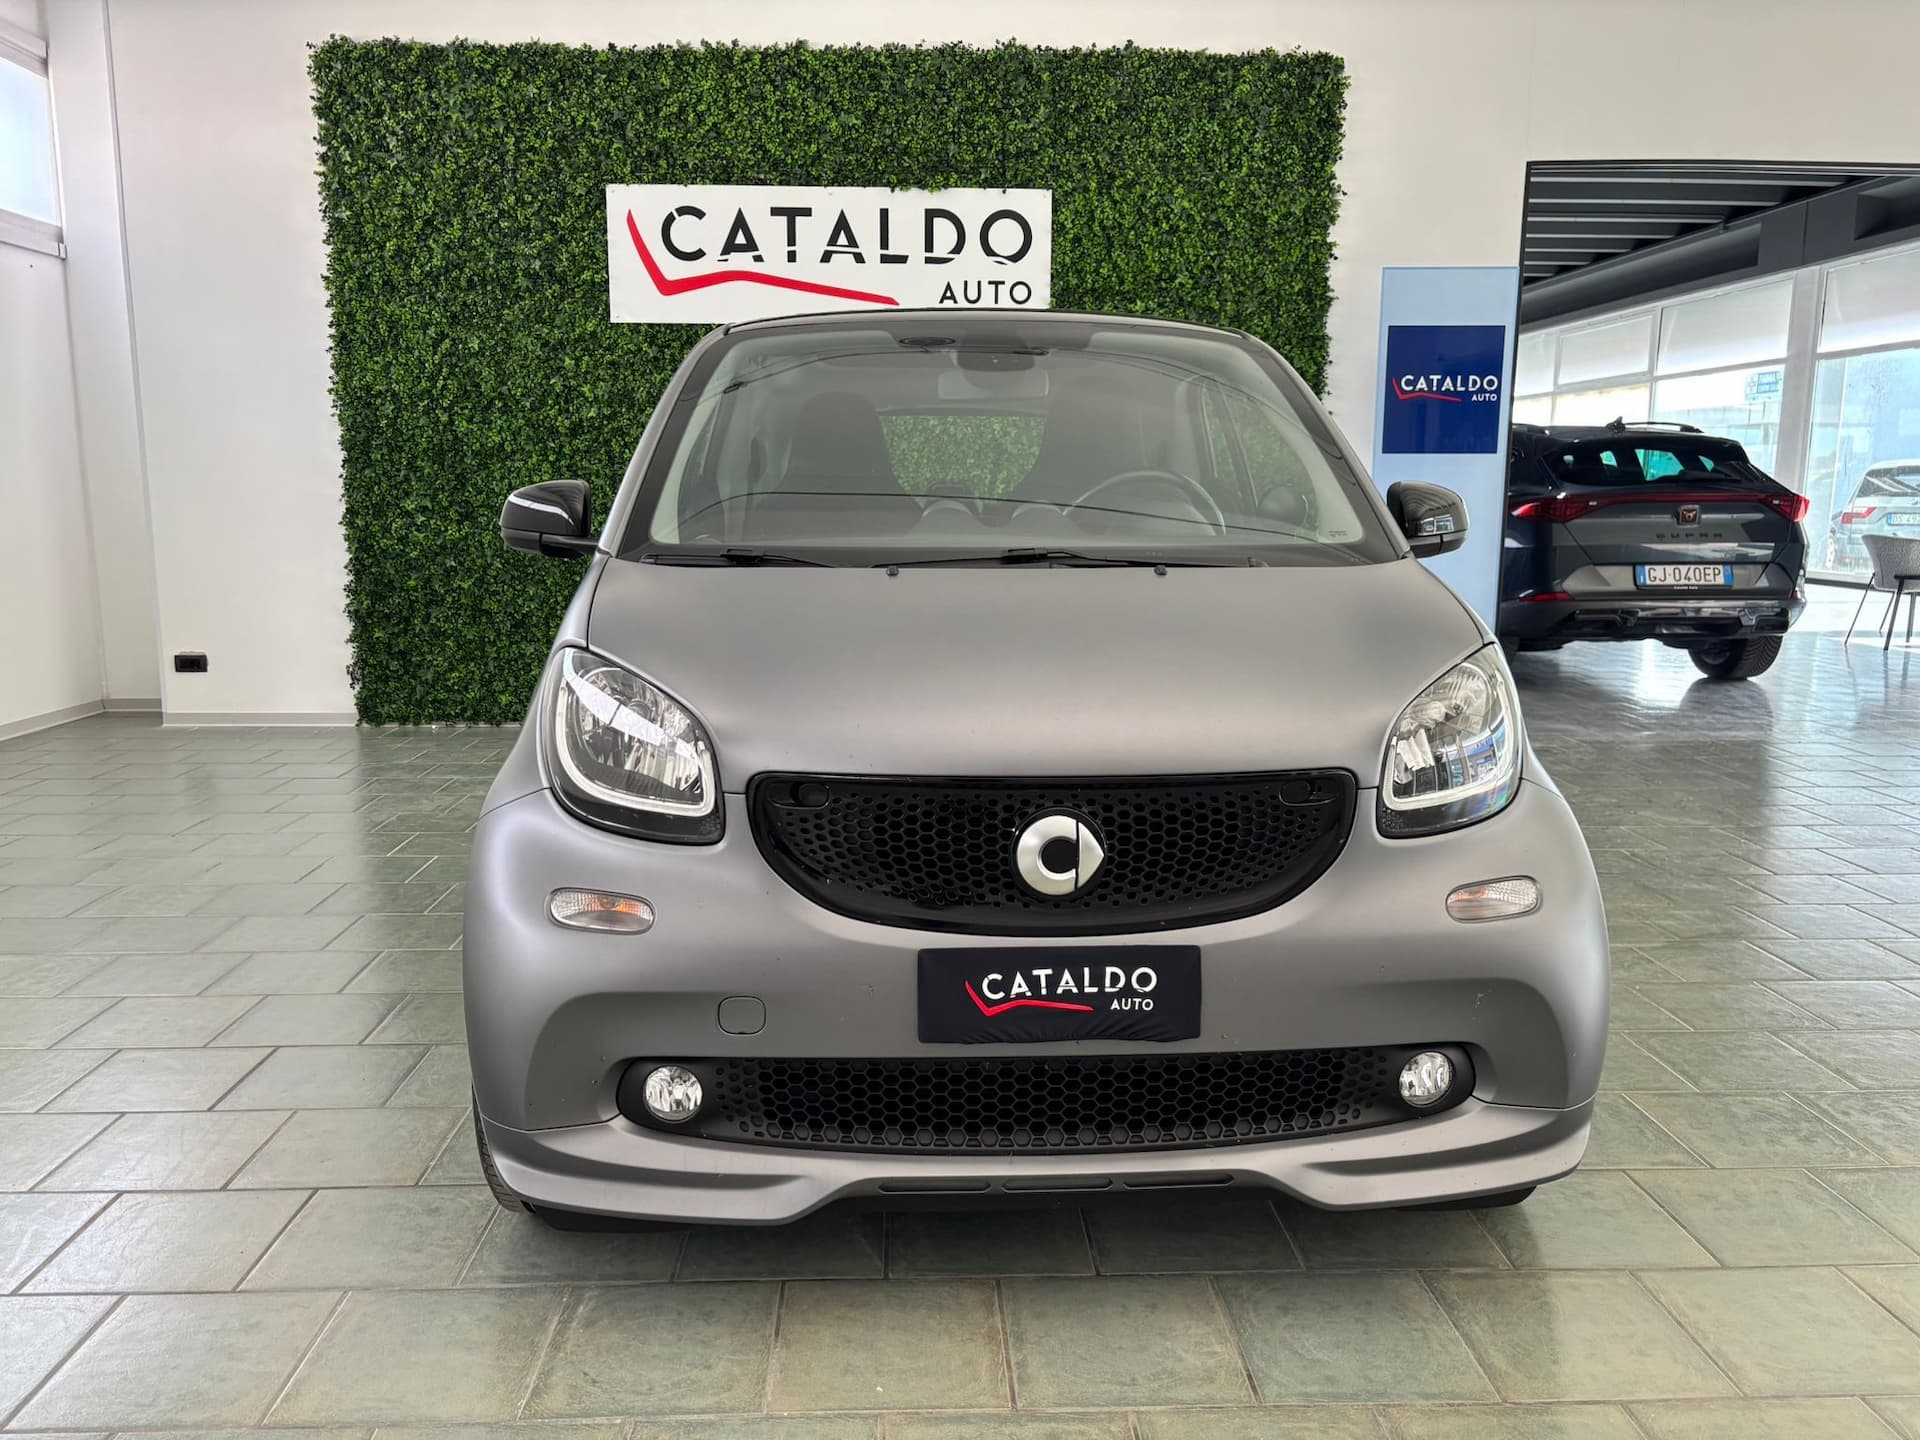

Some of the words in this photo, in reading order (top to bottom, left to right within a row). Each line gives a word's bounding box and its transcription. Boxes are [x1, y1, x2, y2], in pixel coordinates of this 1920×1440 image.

[661, 205, 1032, 265] CATALDO
[938, 280, 1032, 304] AUTO
[1401, 375, 1498, 391] CATALDO
[1472, 393, 1497, 401] AUTO
[982, 966, 1157, 1000] CATALDO
[1110, 998, 1154, 1011] AUTO
